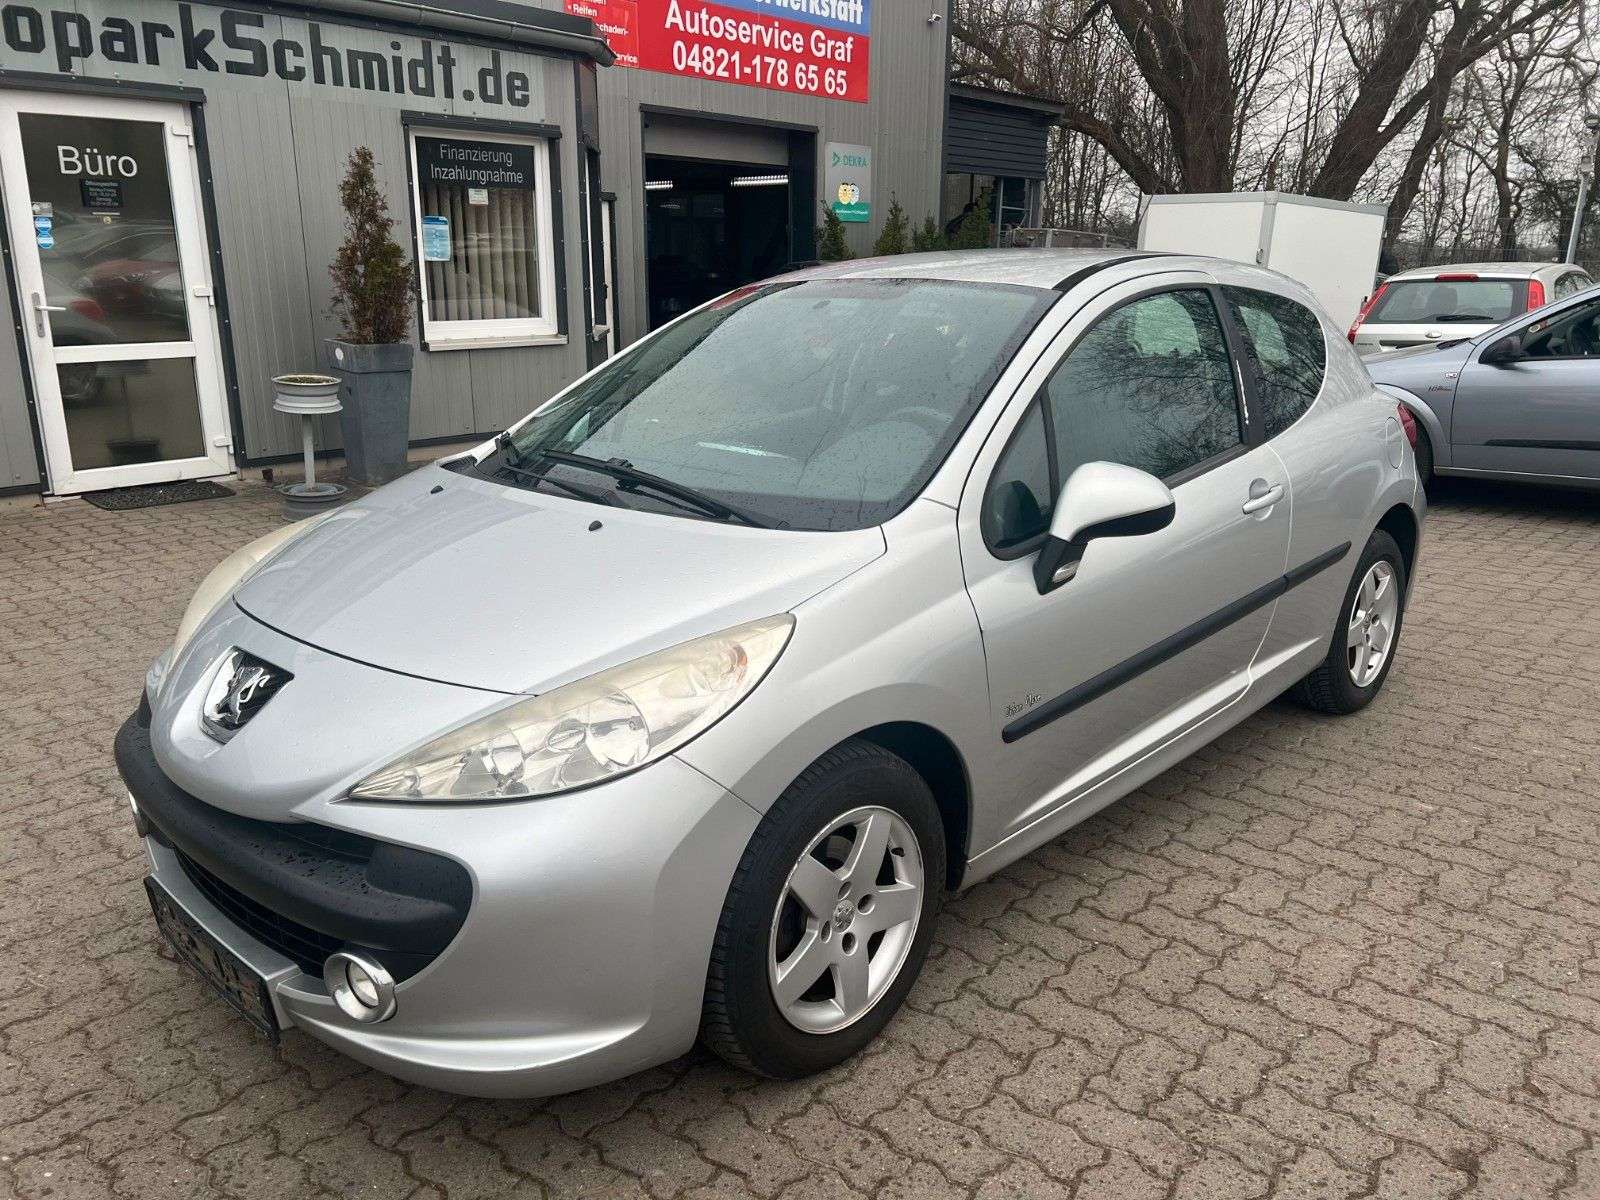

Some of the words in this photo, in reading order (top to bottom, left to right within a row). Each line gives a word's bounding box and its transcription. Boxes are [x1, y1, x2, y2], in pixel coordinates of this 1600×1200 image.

[572, 3, 598, 17] Reifen
[596, 23, 629, 36] chaden-
[664, 0, 804, 55] Autoservice
[810, 29, 854, 63] Graf
[1, 1, 531, 109] oparkSchmidt.de
[614, 52, 638, 64] ervice
[672, 41, 788, 87] 04821-178
[795, 62, 819, 92] 65
[824, 69, 848, 96] 65
[57, 145, 138, 178] Büro
[439, 144, 513, 167] Finanzierung
[430, 163, 524, 185] Inzahlungnahme
